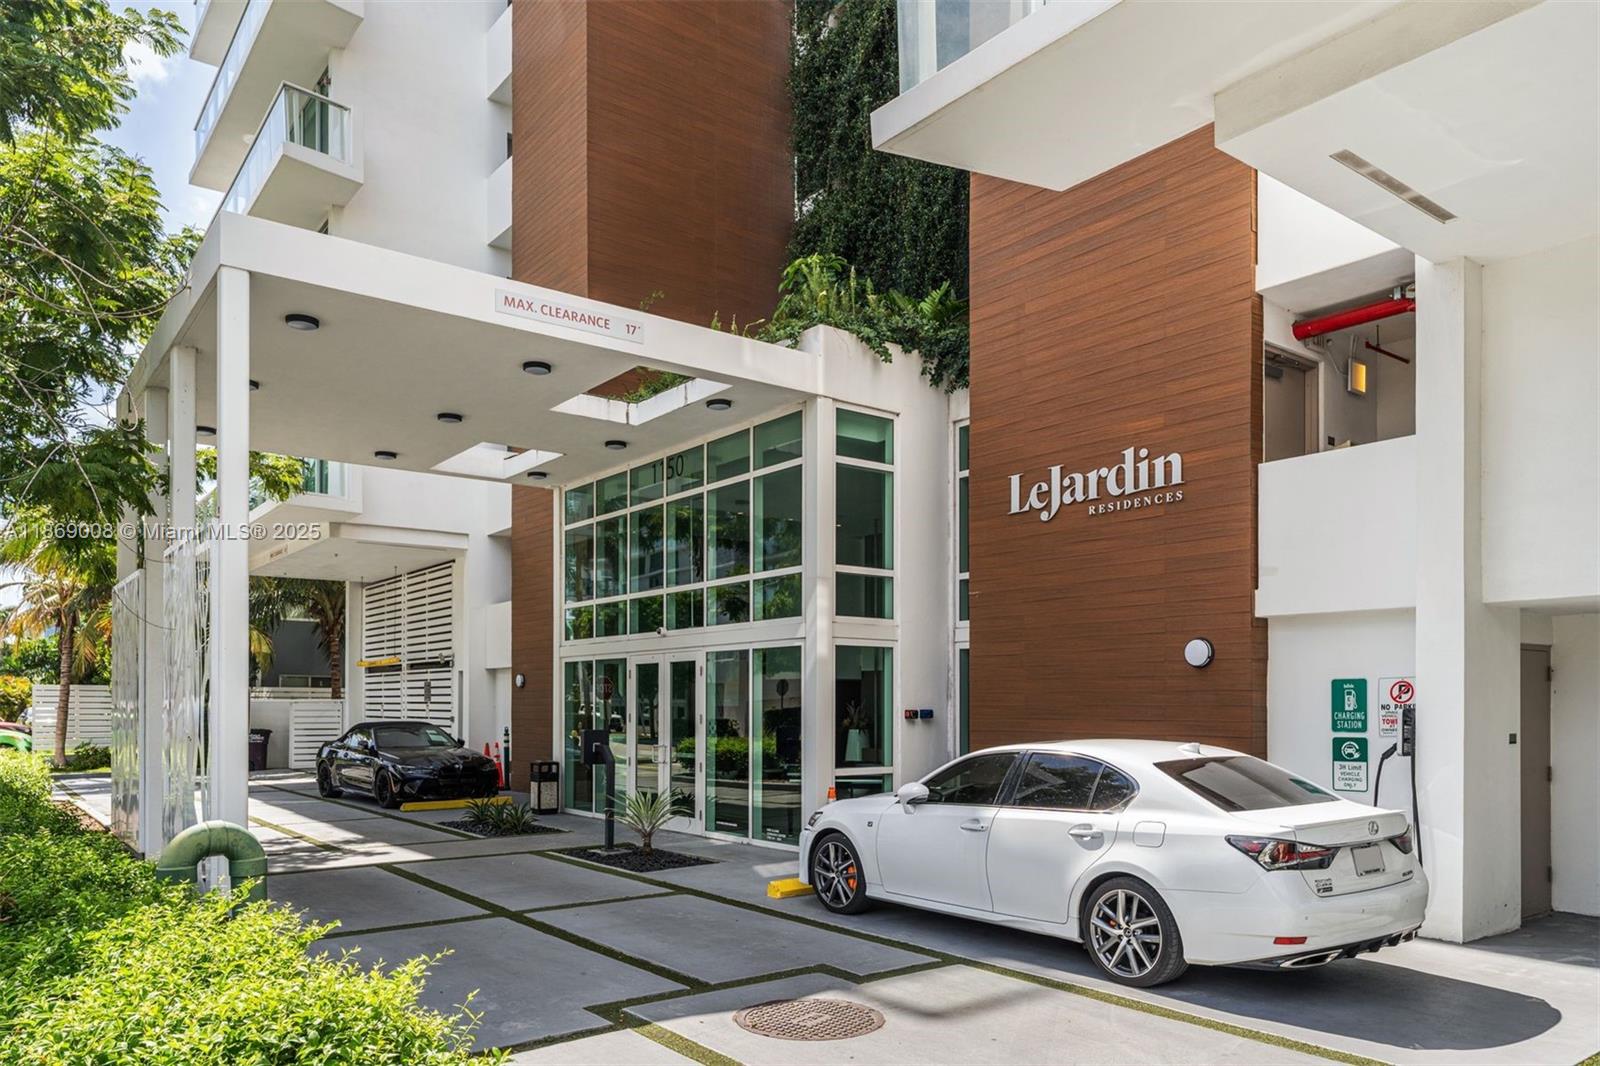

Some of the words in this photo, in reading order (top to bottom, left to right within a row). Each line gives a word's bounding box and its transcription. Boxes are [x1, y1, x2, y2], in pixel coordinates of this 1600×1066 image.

[504, 295, 538, 313] MAX.
[540, 304, 611, 330] CLEARANCE
[1007, 446, 1185, 522] LeJardin
[1088, 490, 1184, 515] RESIDENCES
[1333, 711, 1365, 720] CHARGING
[1381, 703, 1391, 711] NO
[1336, 720, 1362, 729] STATION
